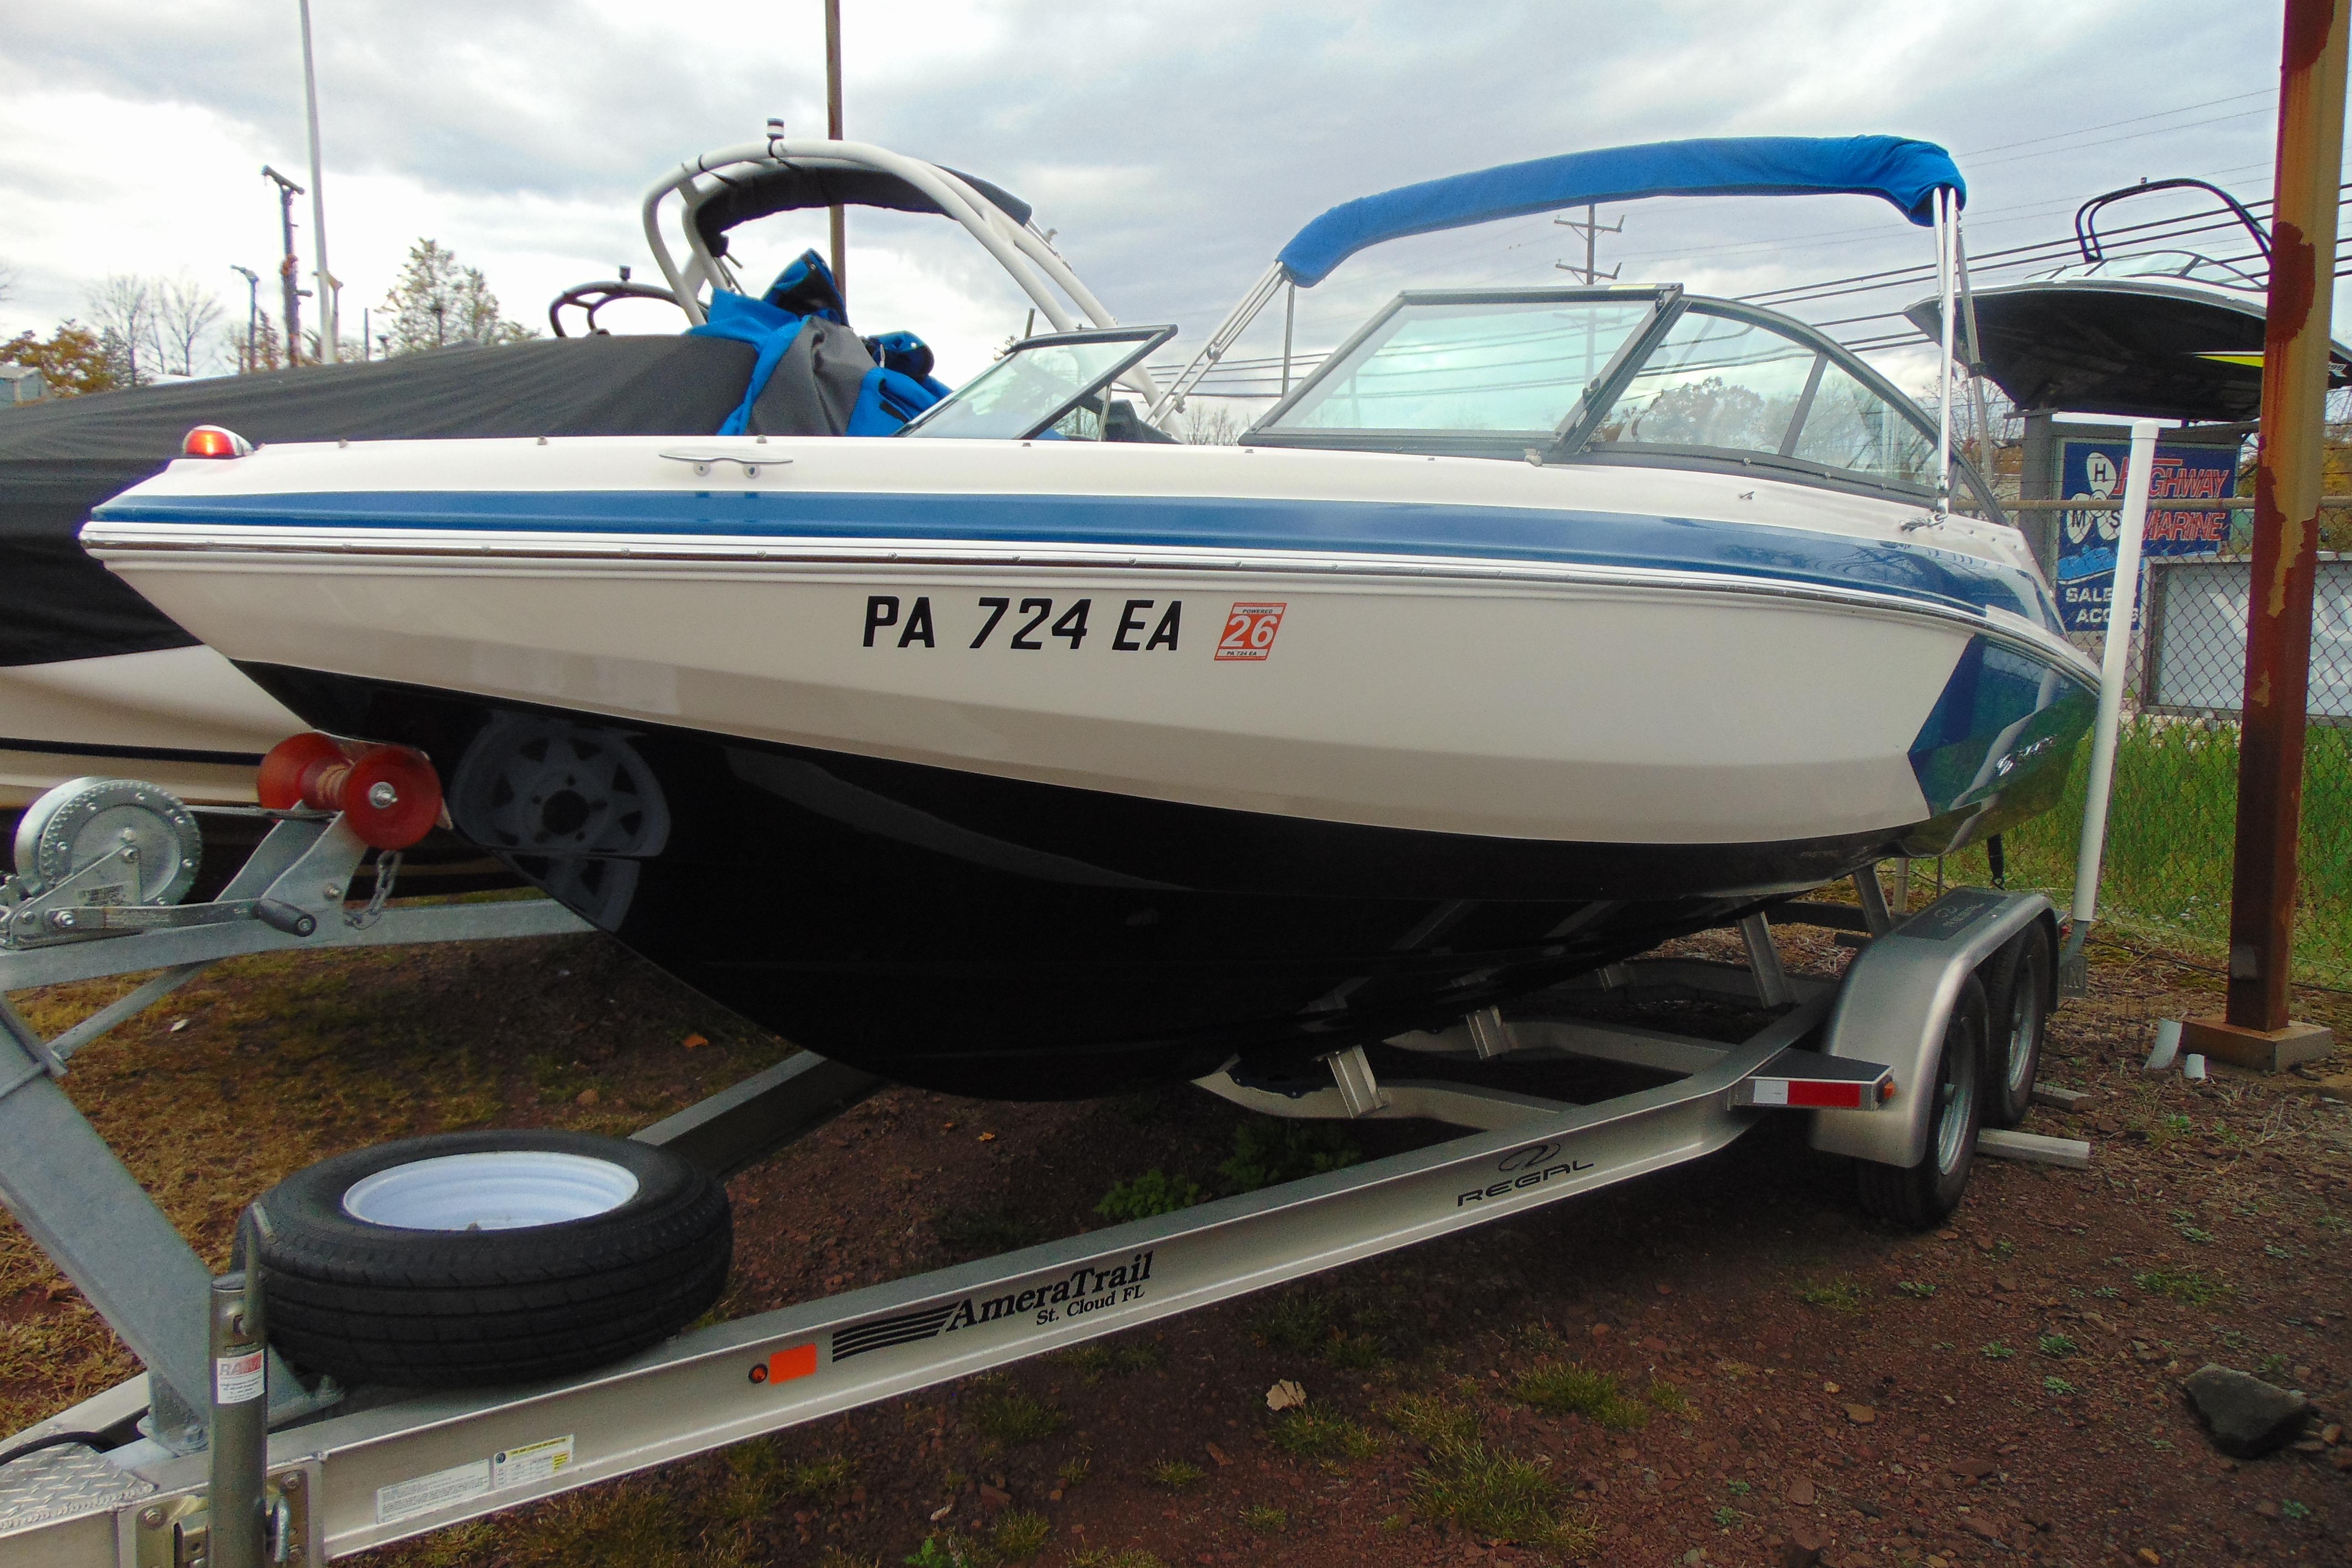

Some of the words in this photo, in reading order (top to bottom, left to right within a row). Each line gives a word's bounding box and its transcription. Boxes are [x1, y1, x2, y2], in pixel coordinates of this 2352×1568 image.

[2095, 463, 2106, 482] H
[863, 596, 935, 648] PA
[969, 597, 1092, 650] 724
[1112, 599, 1182, 651] EA
[1220, 615, 1277, 647] 26
[1457, 1160, 1594, 1207] REGAL
[945, 1250, 1154, 1332] AmeraTrail
[1036, 1308, 1060, 1326] St.
[1067, 1289, 1115, 1317] Cloud
[1121, 1285, 1145, 1303] FL
